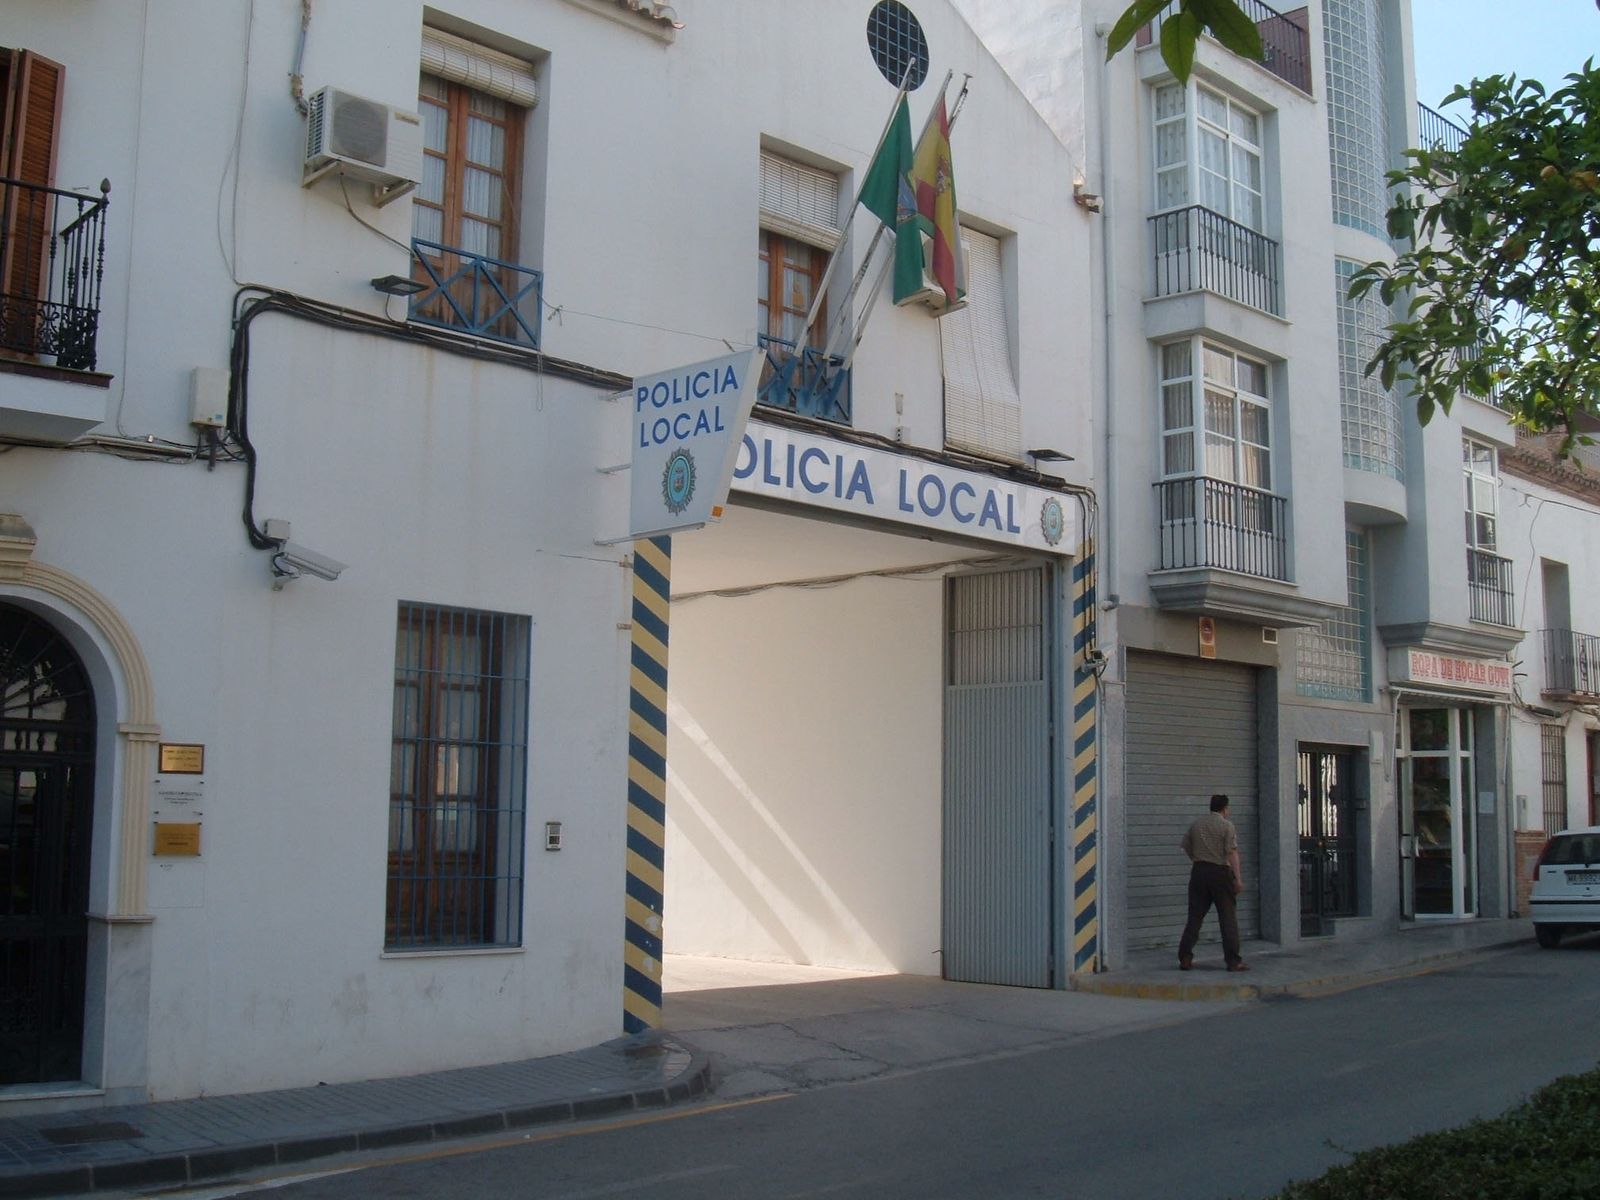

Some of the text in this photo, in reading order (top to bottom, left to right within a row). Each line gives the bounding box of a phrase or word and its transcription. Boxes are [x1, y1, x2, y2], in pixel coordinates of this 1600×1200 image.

[636, 364, 739, 413] POLICIA
[639, 404, 725, 449] LOCAL
[733, 434, 1021, 534] OLICIA LOCAL
[1411, 652, 1439, 678] ROPA
[1440, 657, 1454, 681] DE
[1455, 659, 1486, 685] HOGAR
